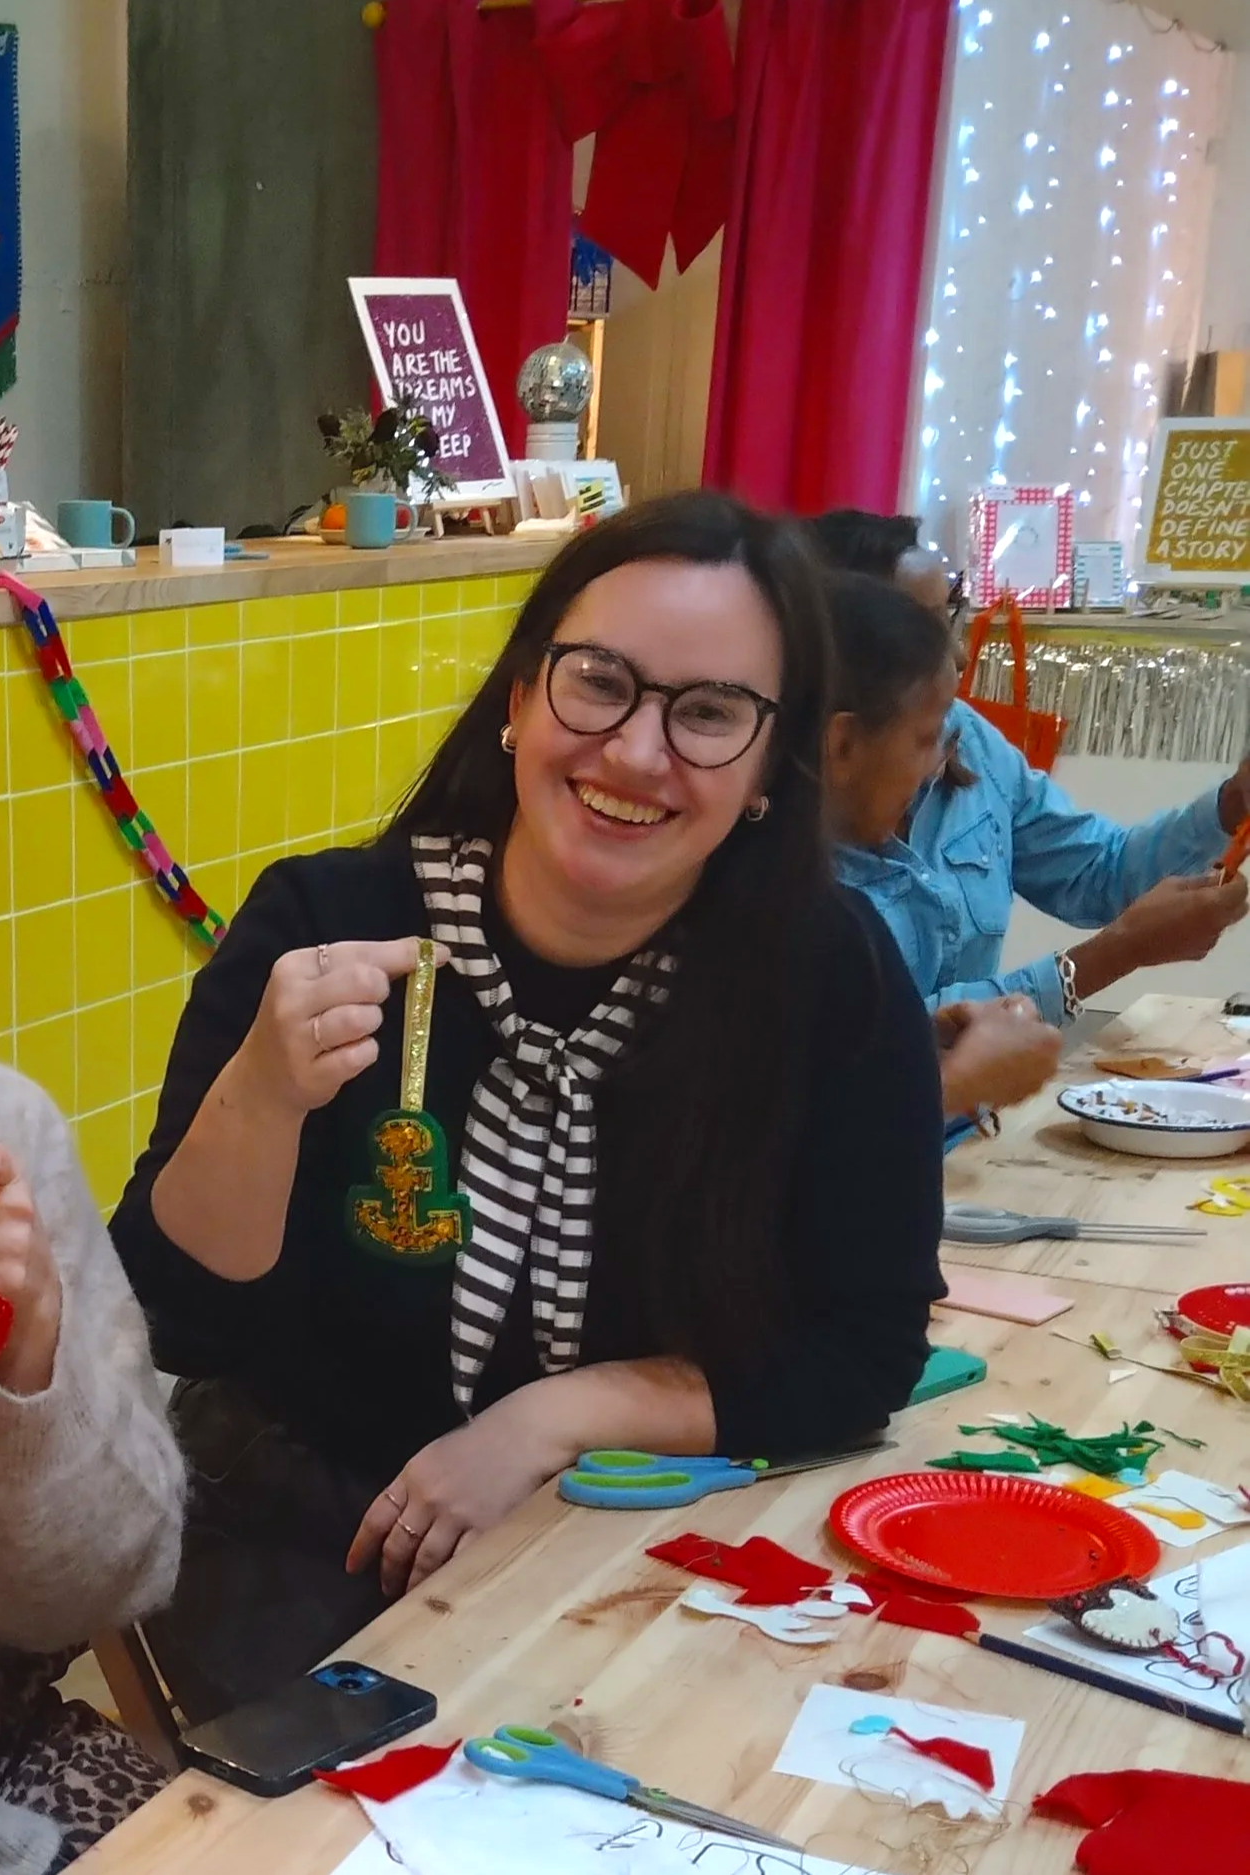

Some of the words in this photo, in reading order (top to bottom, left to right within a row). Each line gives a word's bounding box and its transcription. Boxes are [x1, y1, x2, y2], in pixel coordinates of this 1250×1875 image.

[383, 320, 425, 348] YOU
[392, 352, 430, 378] ARE
[430, 349, 463, 374] THE
[432, 402, 456, 428] MY
[1171, 441, 1238, 459] JUST
[1171, 461, 1226, 479] ONE
[1163, 481, 1250, 503] CHAPTE
[1161, 499, 1250, 517] DOESN'T
[1160, 519, 1248, 537] DEFINE
[1156, 539, 1171, 558] A
[1172, 539, 1247, 562] STORY
